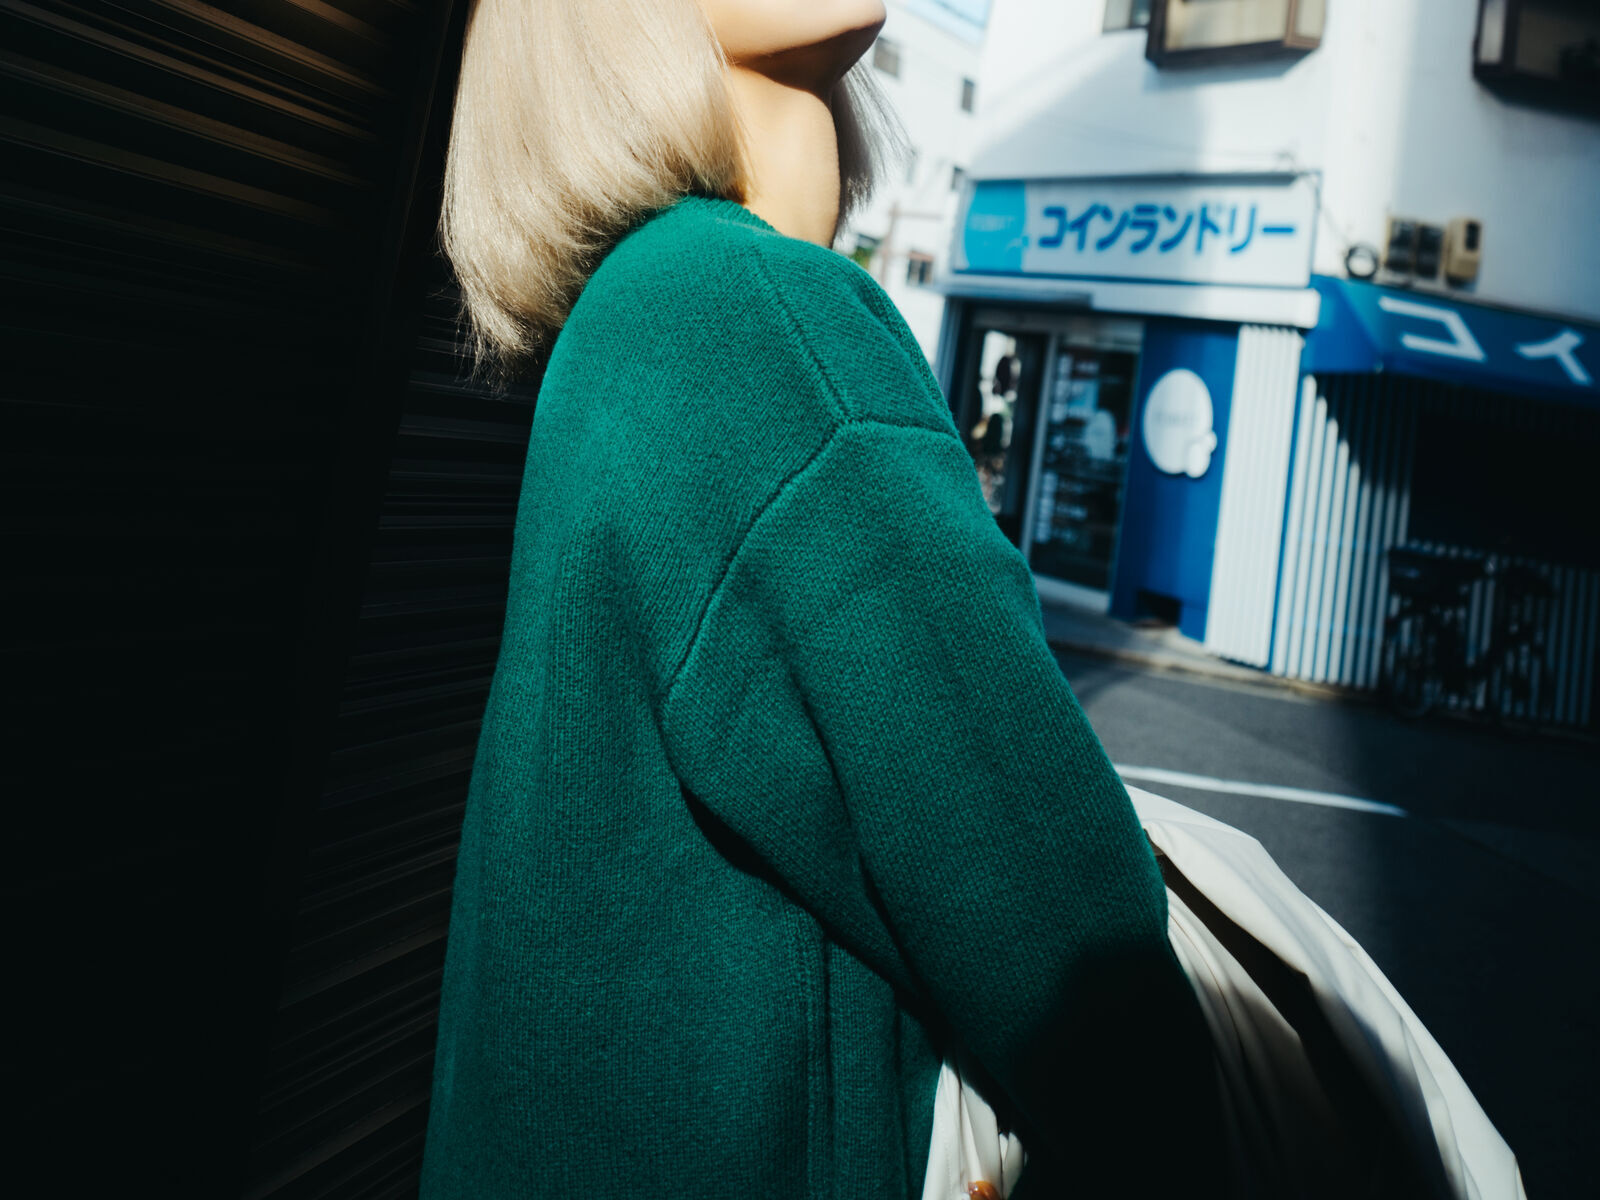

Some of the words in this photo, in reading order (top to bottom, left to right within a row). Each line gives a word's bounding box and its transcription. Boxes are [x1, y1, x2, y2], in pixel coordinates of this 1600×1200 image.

[1038, 203, 1296, 253] コインランドリー
[1379, 297, 1590, 385] コイ
